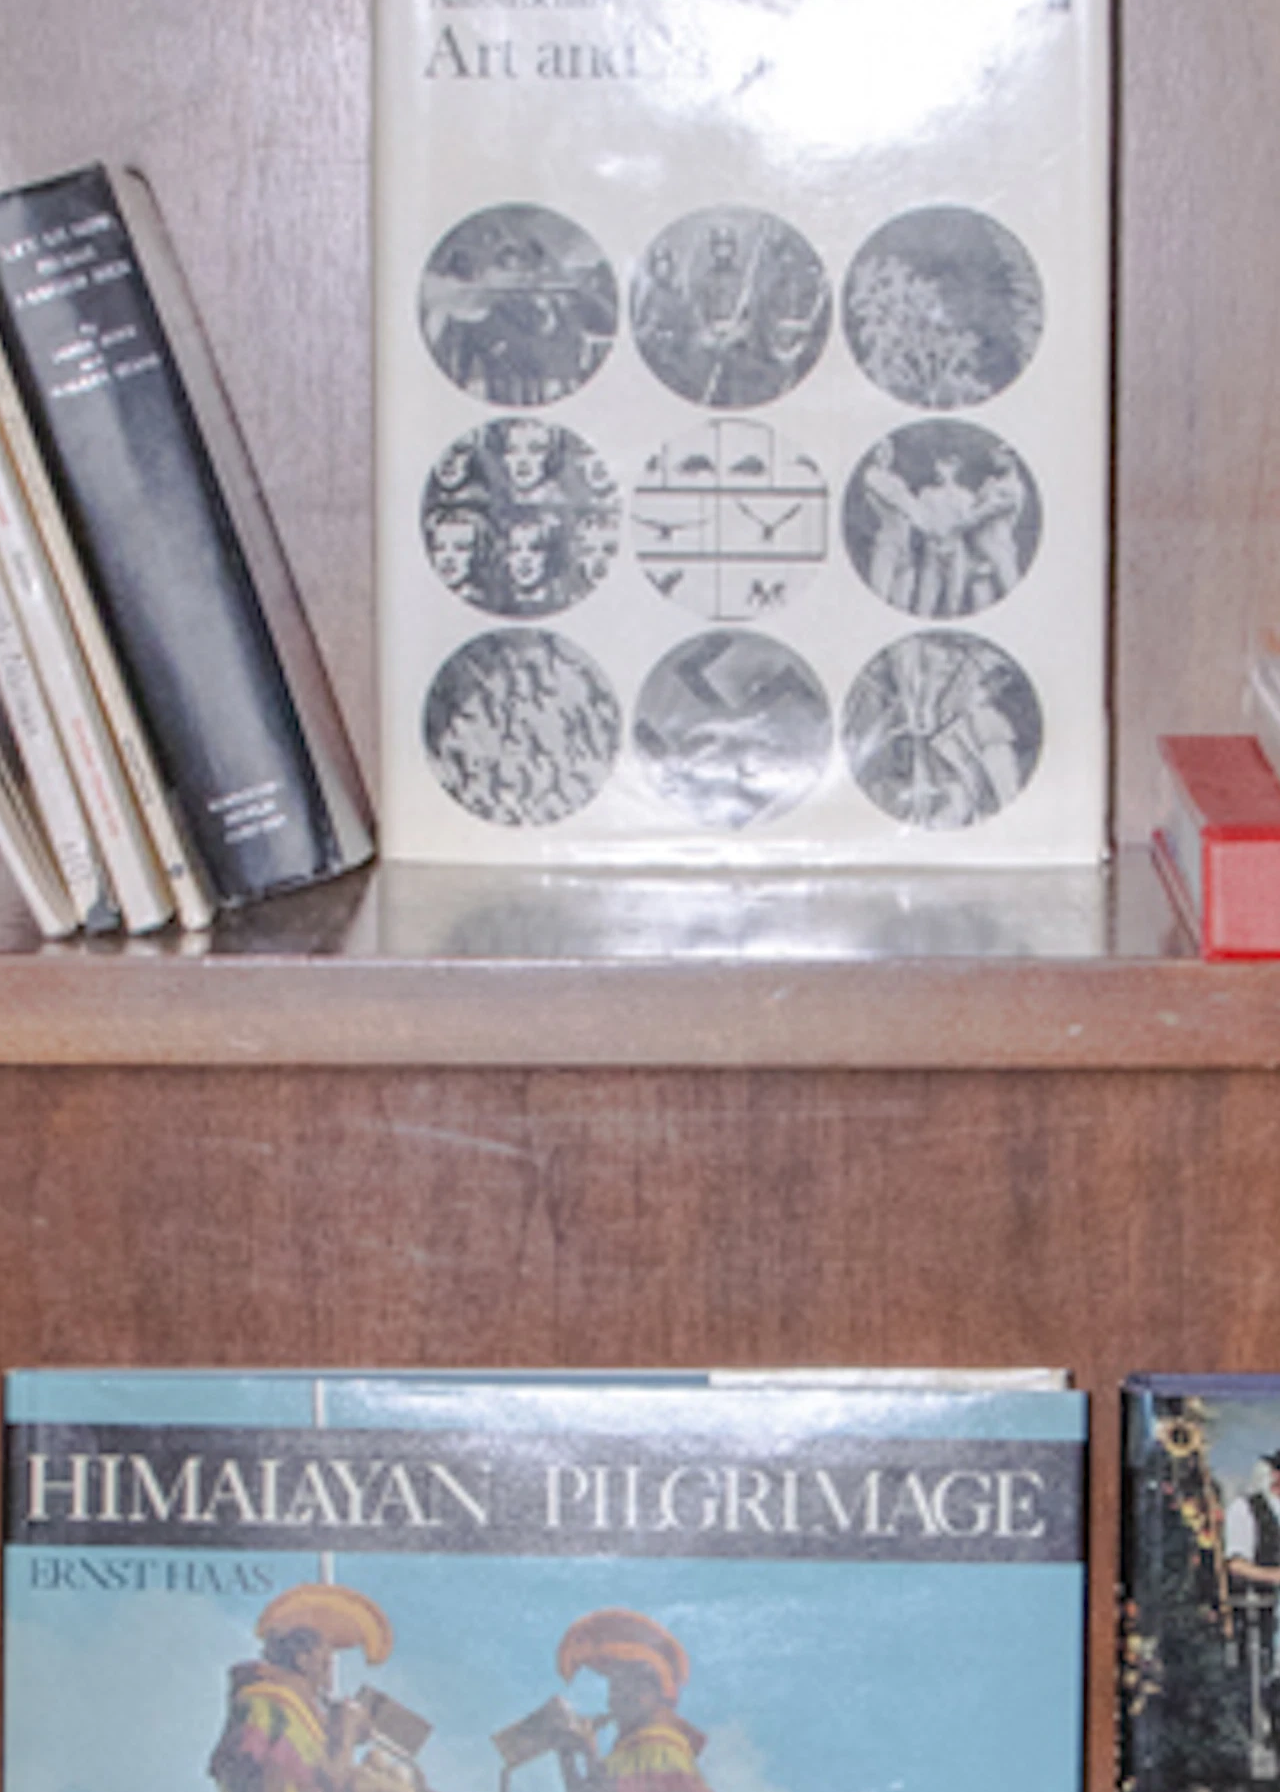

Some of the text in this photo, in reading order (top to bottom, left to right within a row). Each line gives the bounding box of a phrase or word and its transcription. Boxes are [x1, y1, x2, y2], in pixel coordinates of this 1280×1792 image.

[423, 23, 519, 80] Art
[24, 1451, 1050, 1540] HIMALAYAN PILGRIMAGE
[28, 1556, 275, 1596] ERNST HAAS
